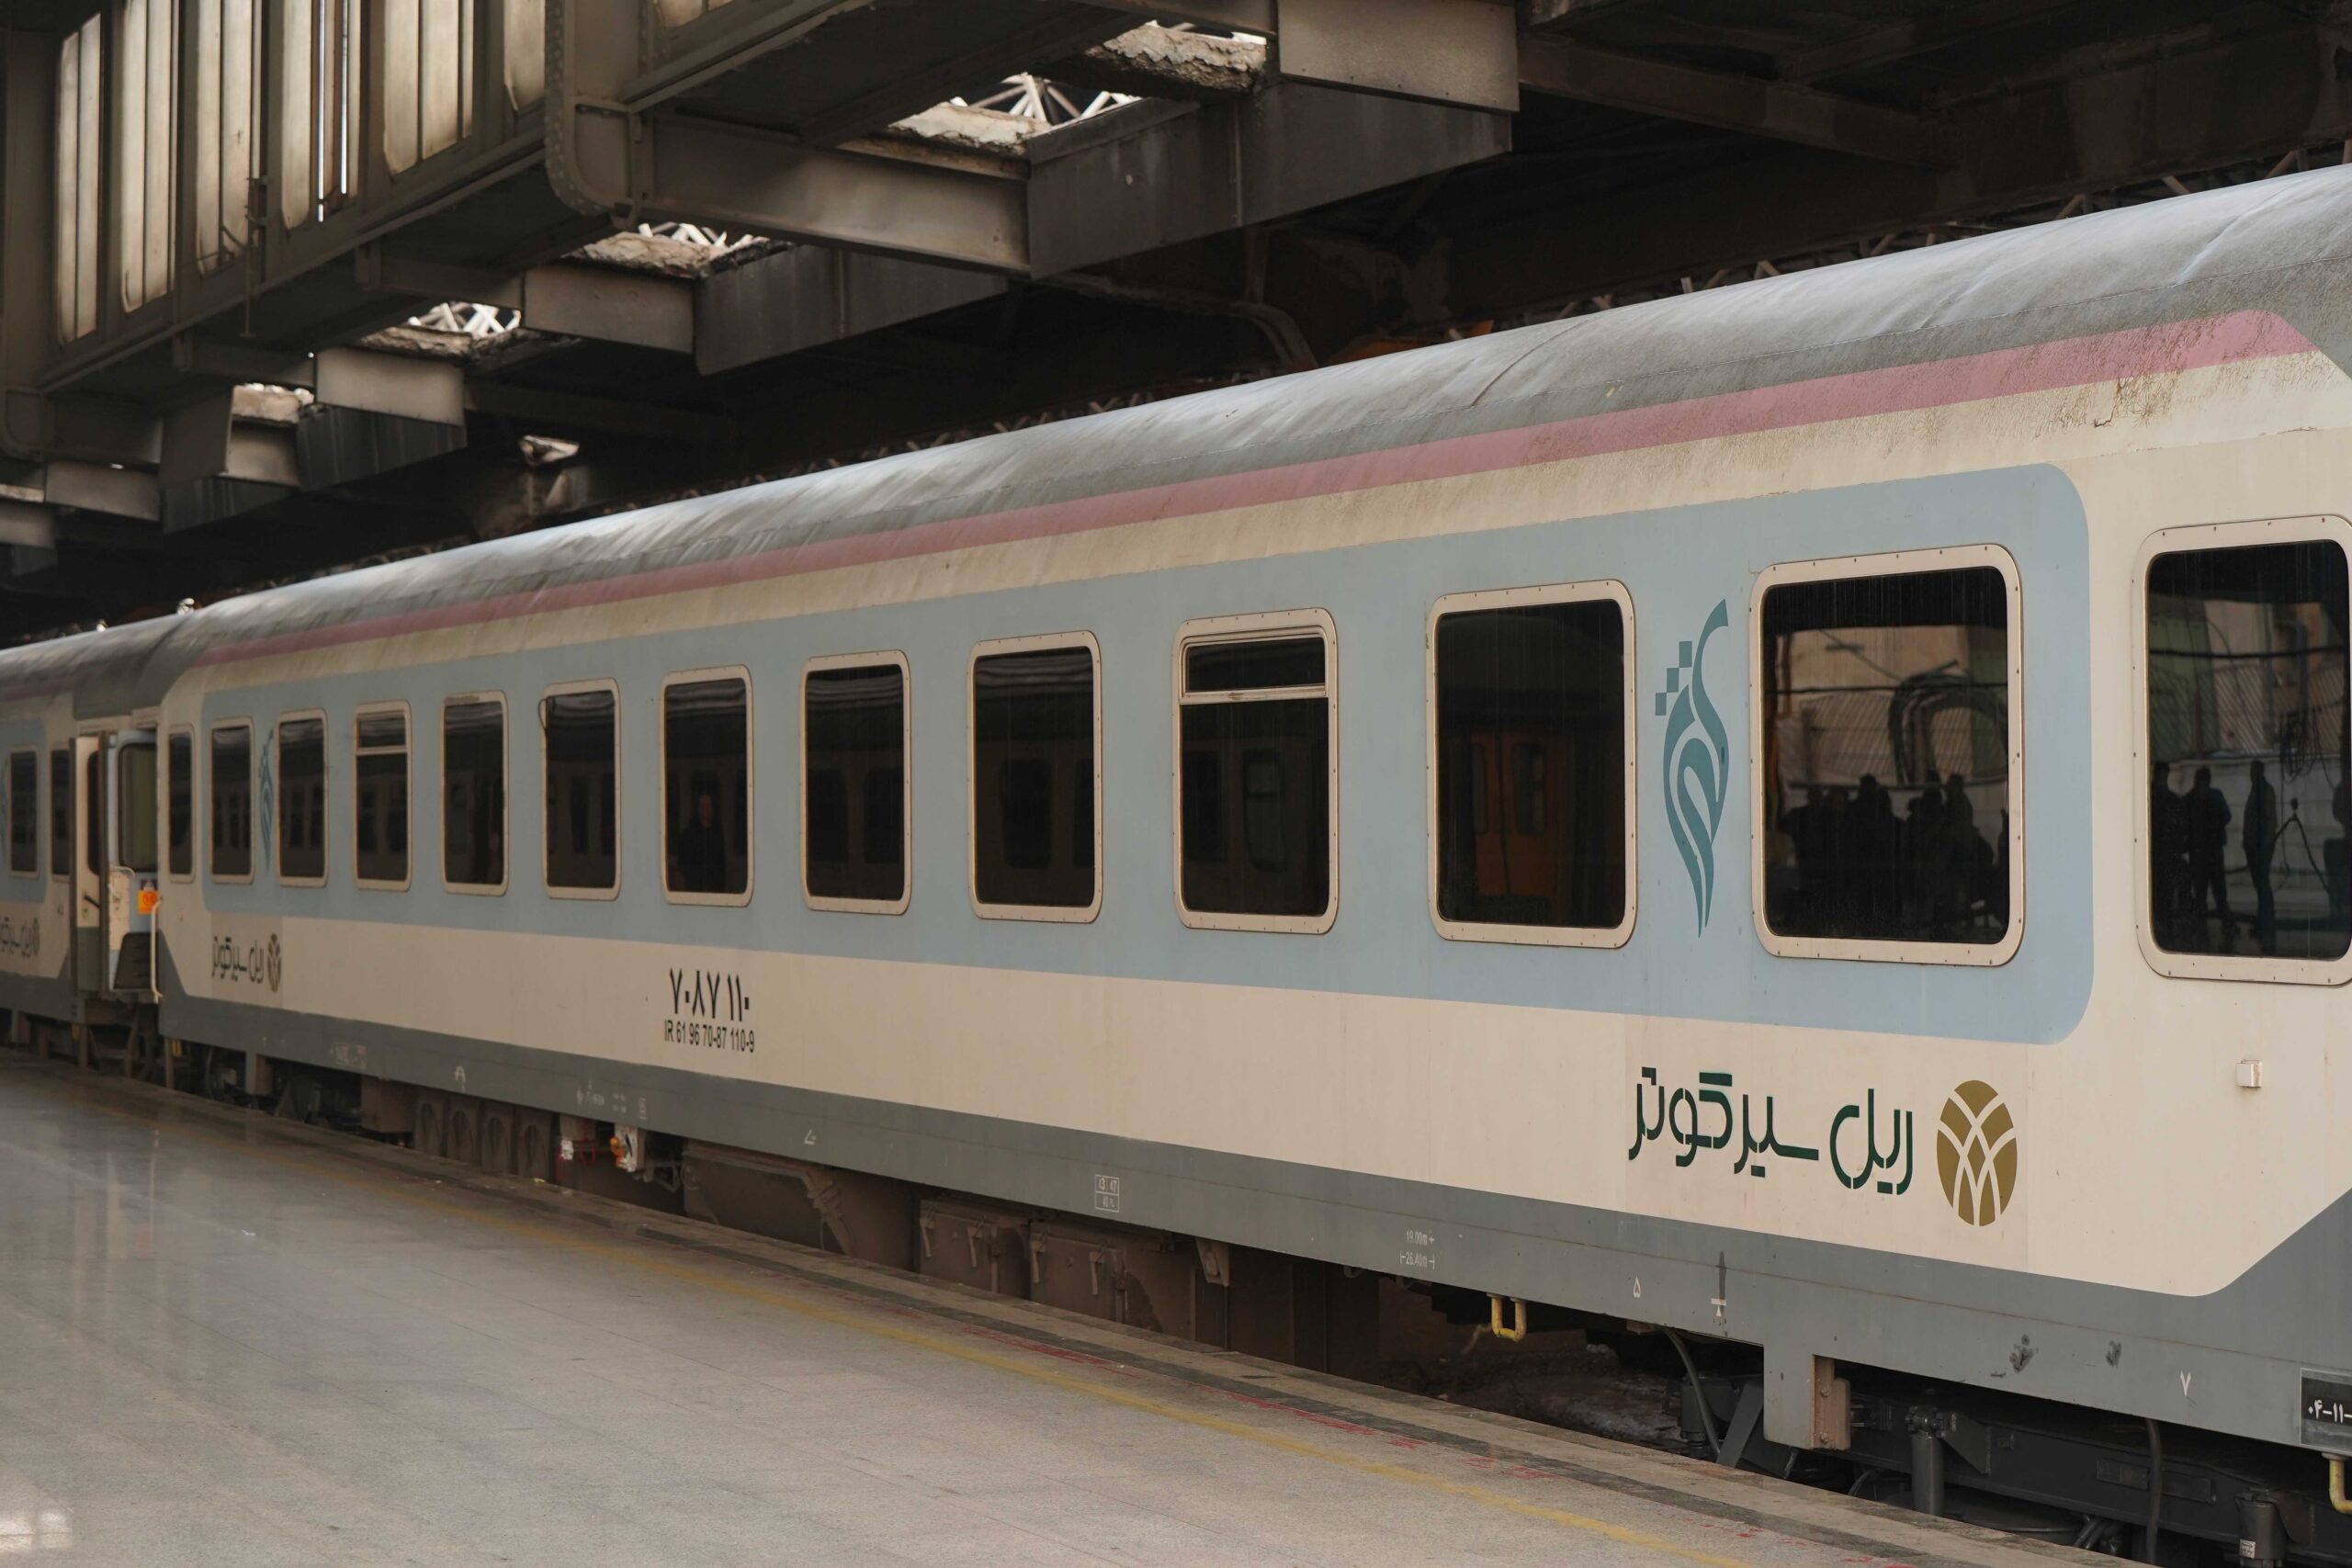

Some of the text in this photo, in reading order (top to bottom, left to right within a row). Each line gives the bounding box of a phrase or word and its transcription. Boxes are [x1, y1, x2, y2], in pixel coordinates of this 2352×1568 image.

[664, 1019, 754, 1053] IR 61 96 70-87 110-9
[1733, 1093, 1820, 1179] سیر
[1829, 1088, 1914, 1196] ریل
